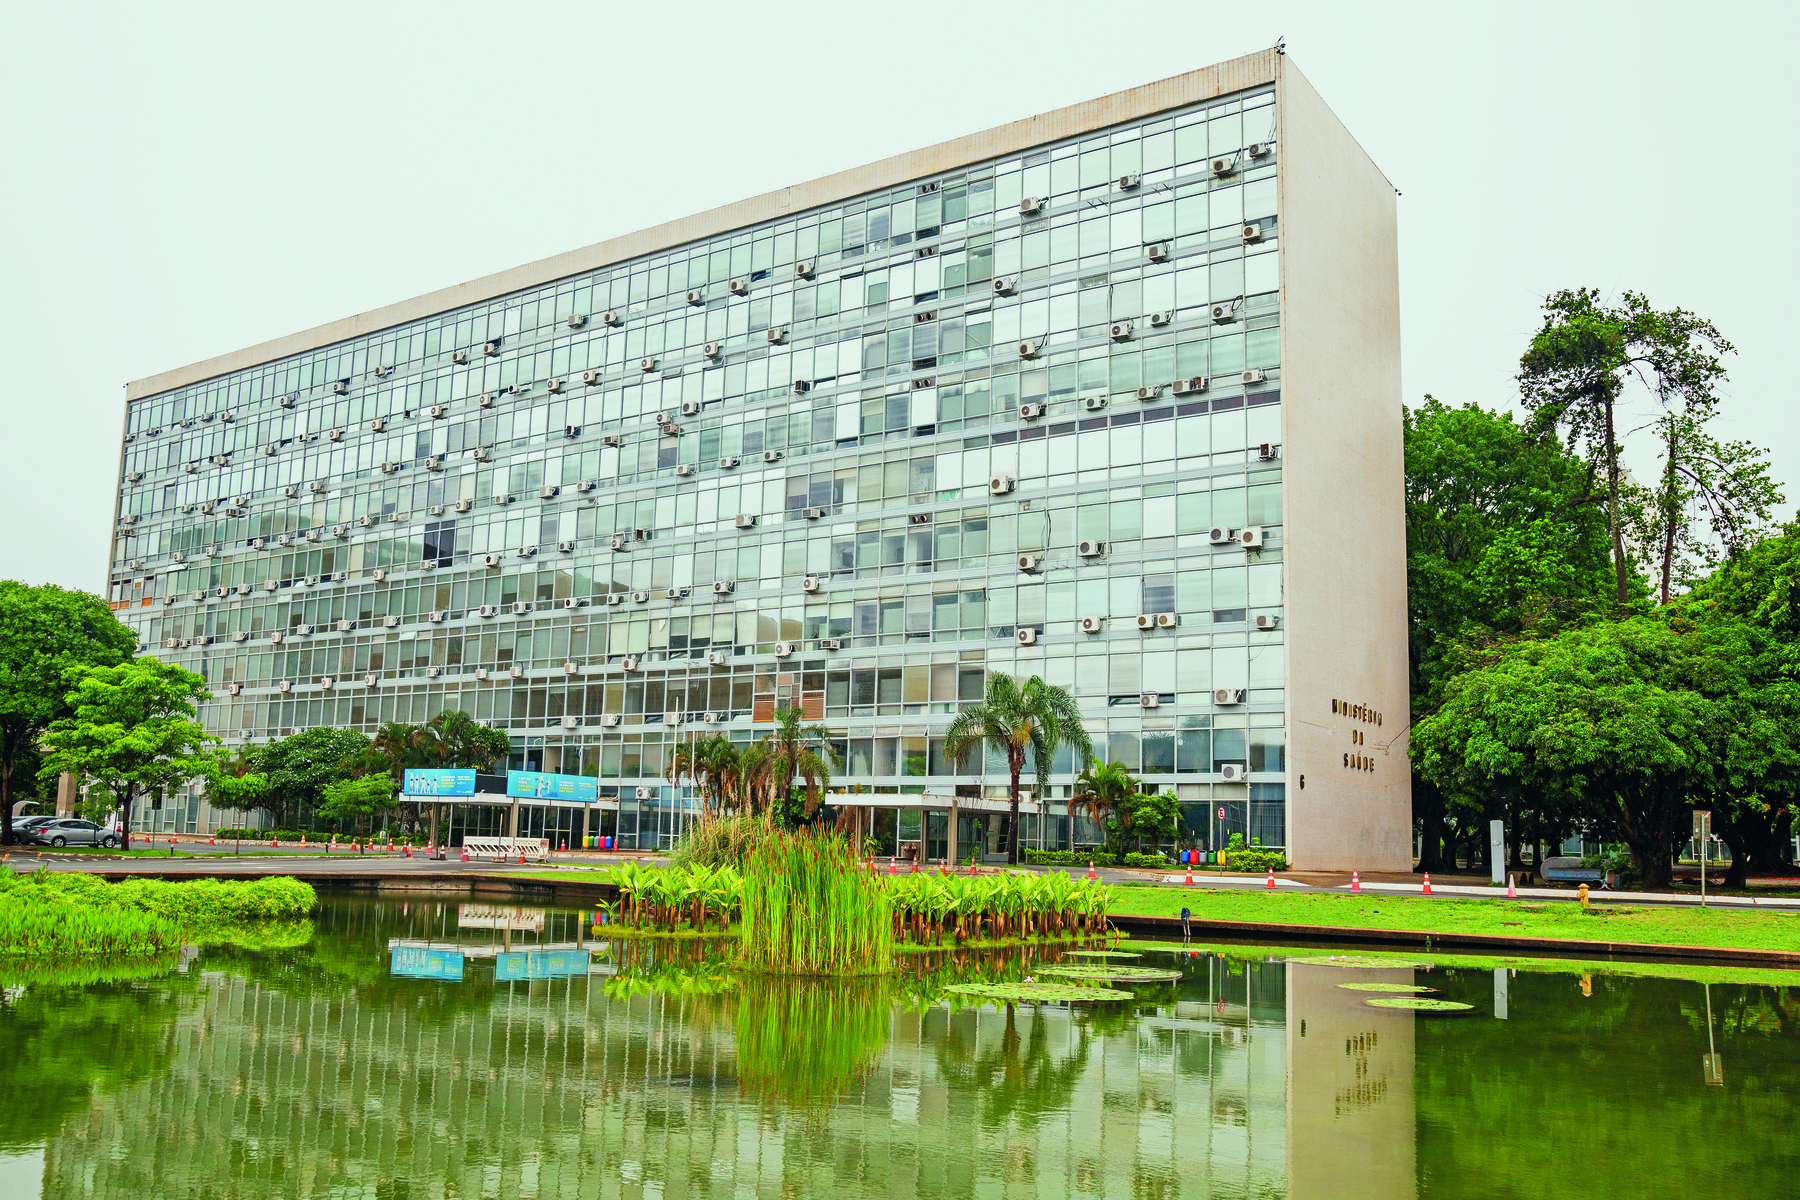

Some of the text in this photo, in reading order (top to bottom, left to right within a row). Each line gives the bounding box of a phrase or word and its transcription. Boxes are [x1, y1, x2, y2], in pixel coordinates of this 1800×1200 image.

[1332, 698, 1382, 727] MINISTÉRIO
[1353, 729, 1363, 746] DA
[1343, 751, 1374, 773] SAÚDE
